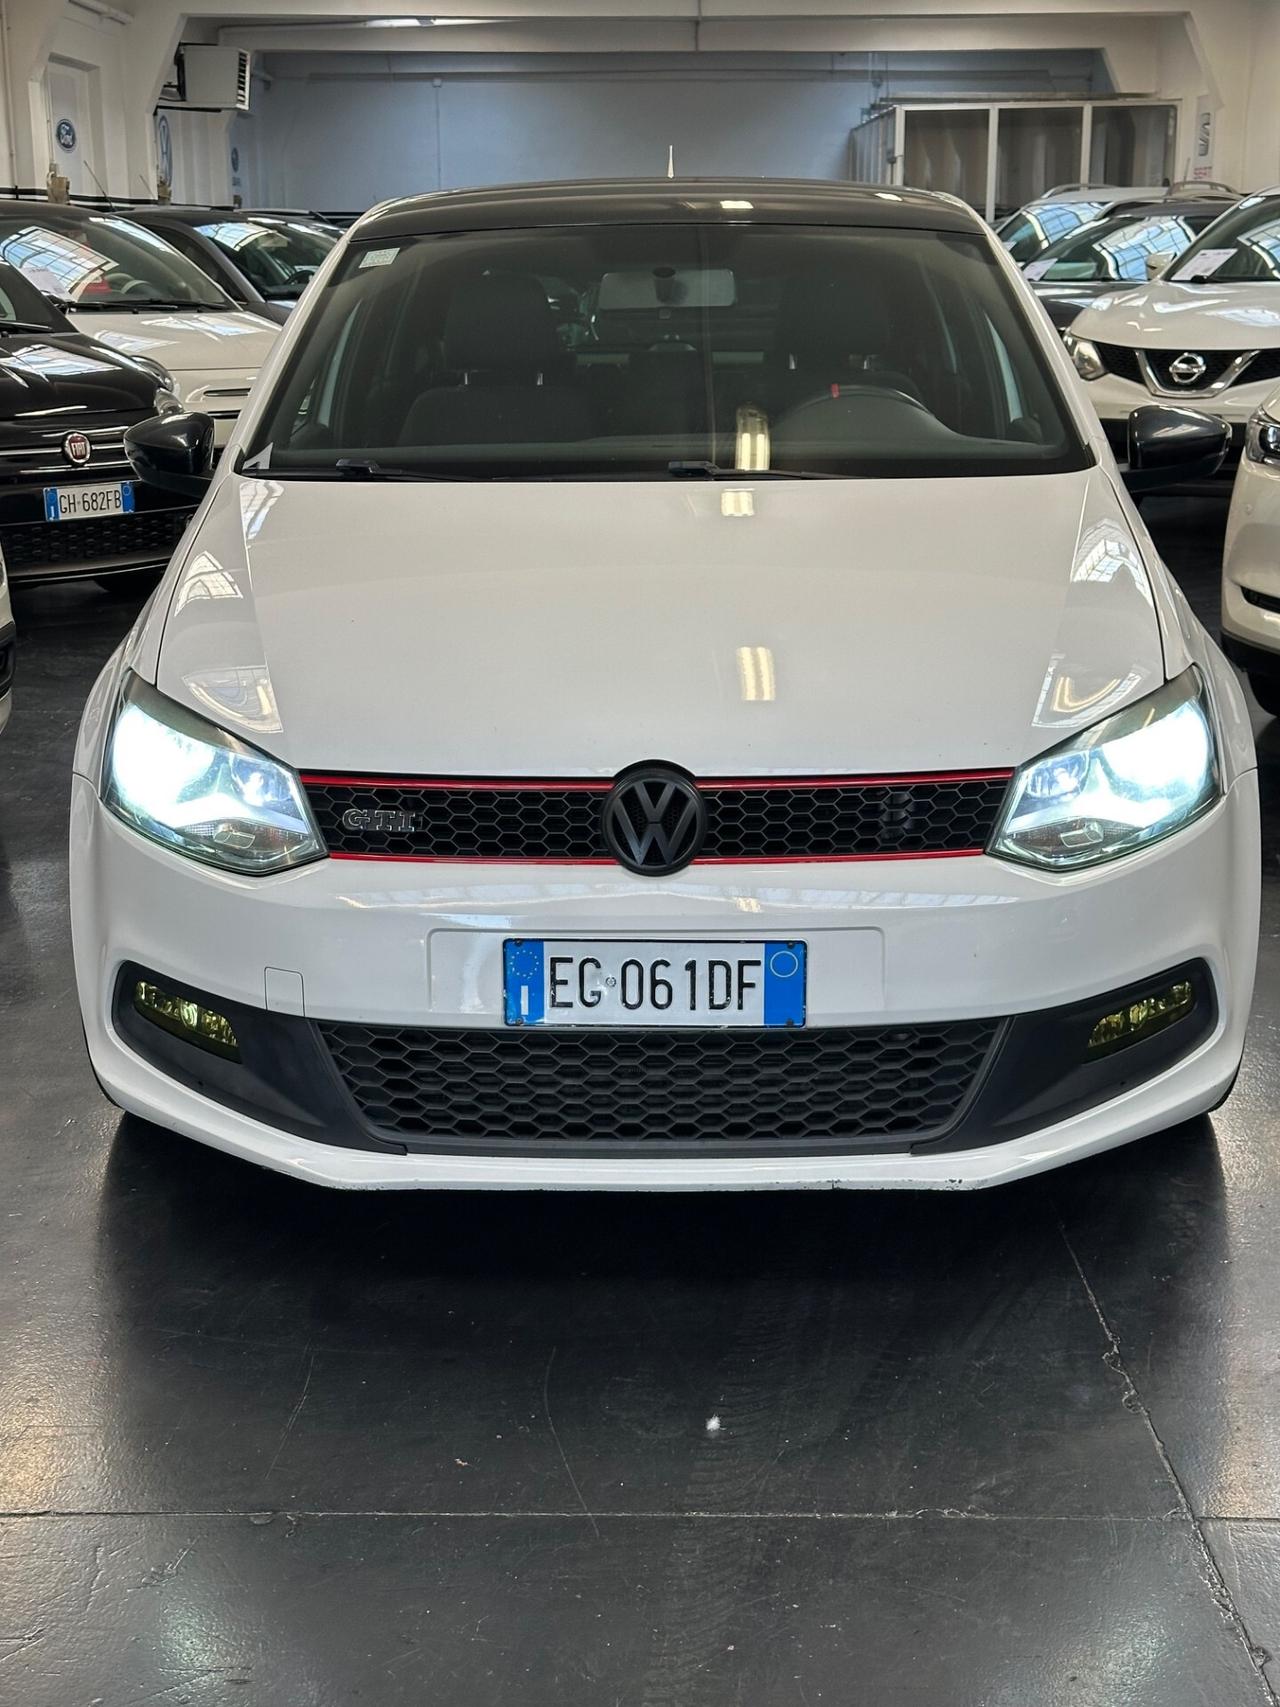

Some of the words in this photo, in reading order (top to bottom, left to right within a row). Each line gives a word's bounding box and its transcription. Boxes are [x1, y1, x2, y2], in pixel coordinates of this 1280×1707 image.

[342, 808, 416, 832] GTI
[550, 956, 602, 1009] EG
[620, 957, 762, 1011] 061DF
